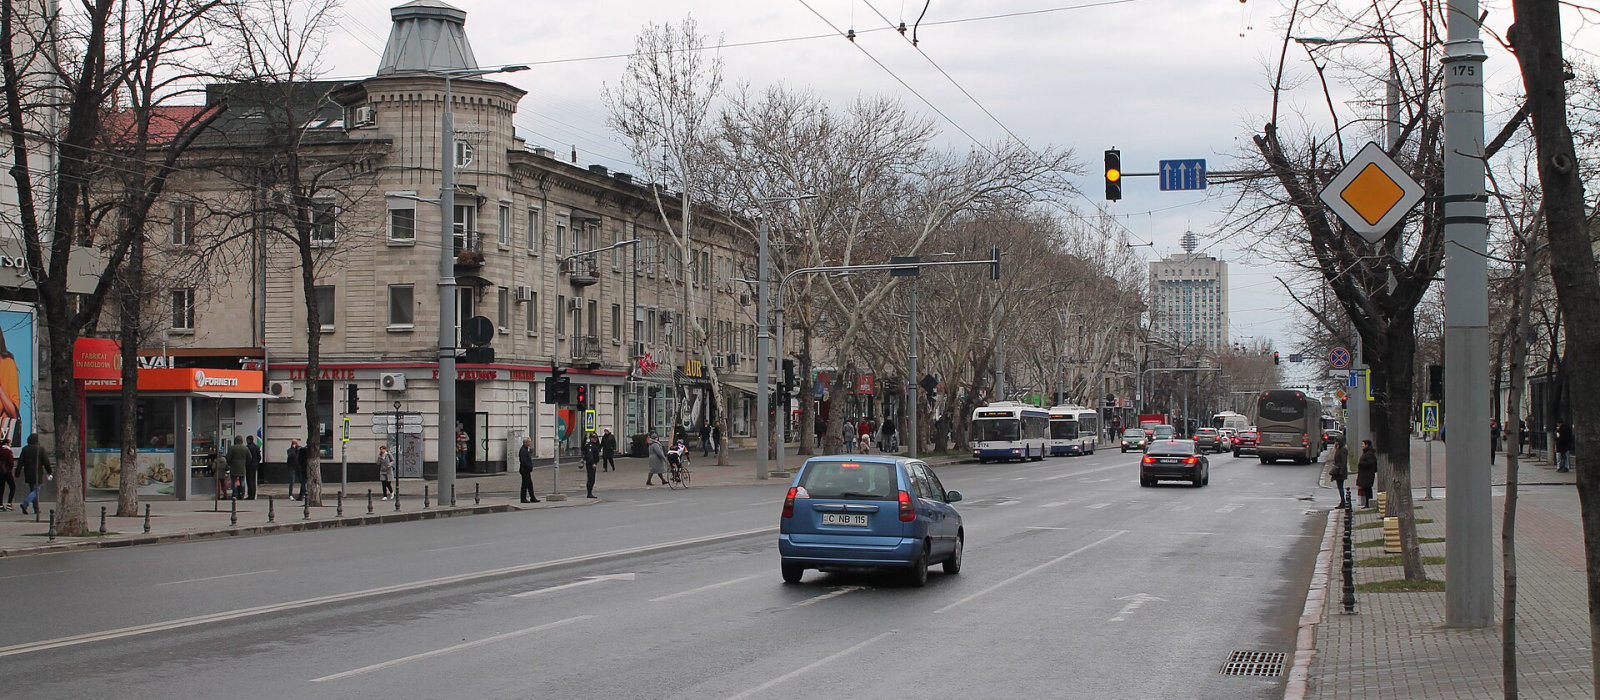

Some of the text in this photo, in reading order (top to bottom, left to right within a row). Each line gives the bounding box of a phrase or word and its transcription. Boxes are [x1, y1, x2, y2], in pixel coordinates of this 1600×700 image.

[1452, 65, 1475, 76] 175
[686, 359, 702, 377] AUR
[205, 377, 238, 386] FORNETTI
[828, 514, 866, 524] C NB 115
